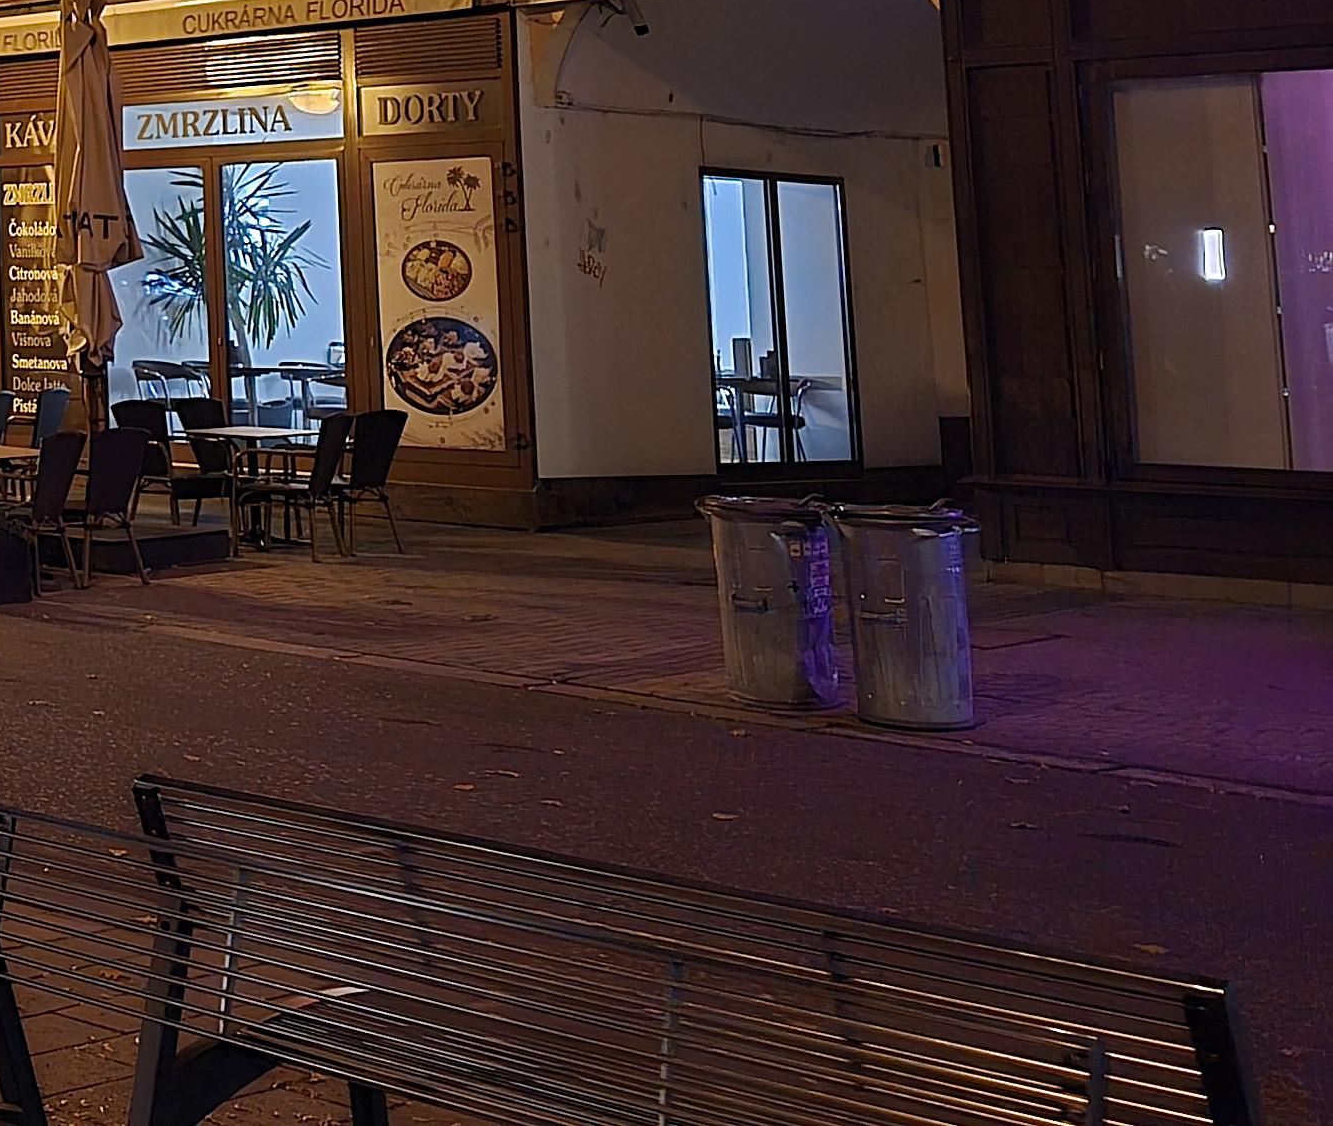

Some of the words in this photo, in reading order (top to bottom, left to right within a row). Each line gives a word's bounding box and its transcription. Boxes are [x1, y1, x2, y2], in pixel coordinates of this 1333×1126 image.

[183, 3, 298, 35] CUKRÁRNA
[136, 104, 293, 141] ZMRZLINA
[377, 89, 484, 126] DORTY
[5, 114, 55, 149] KÁV
[10, 309, 60, 326] Banánová
[13, 375, 43, 393] Dolce
